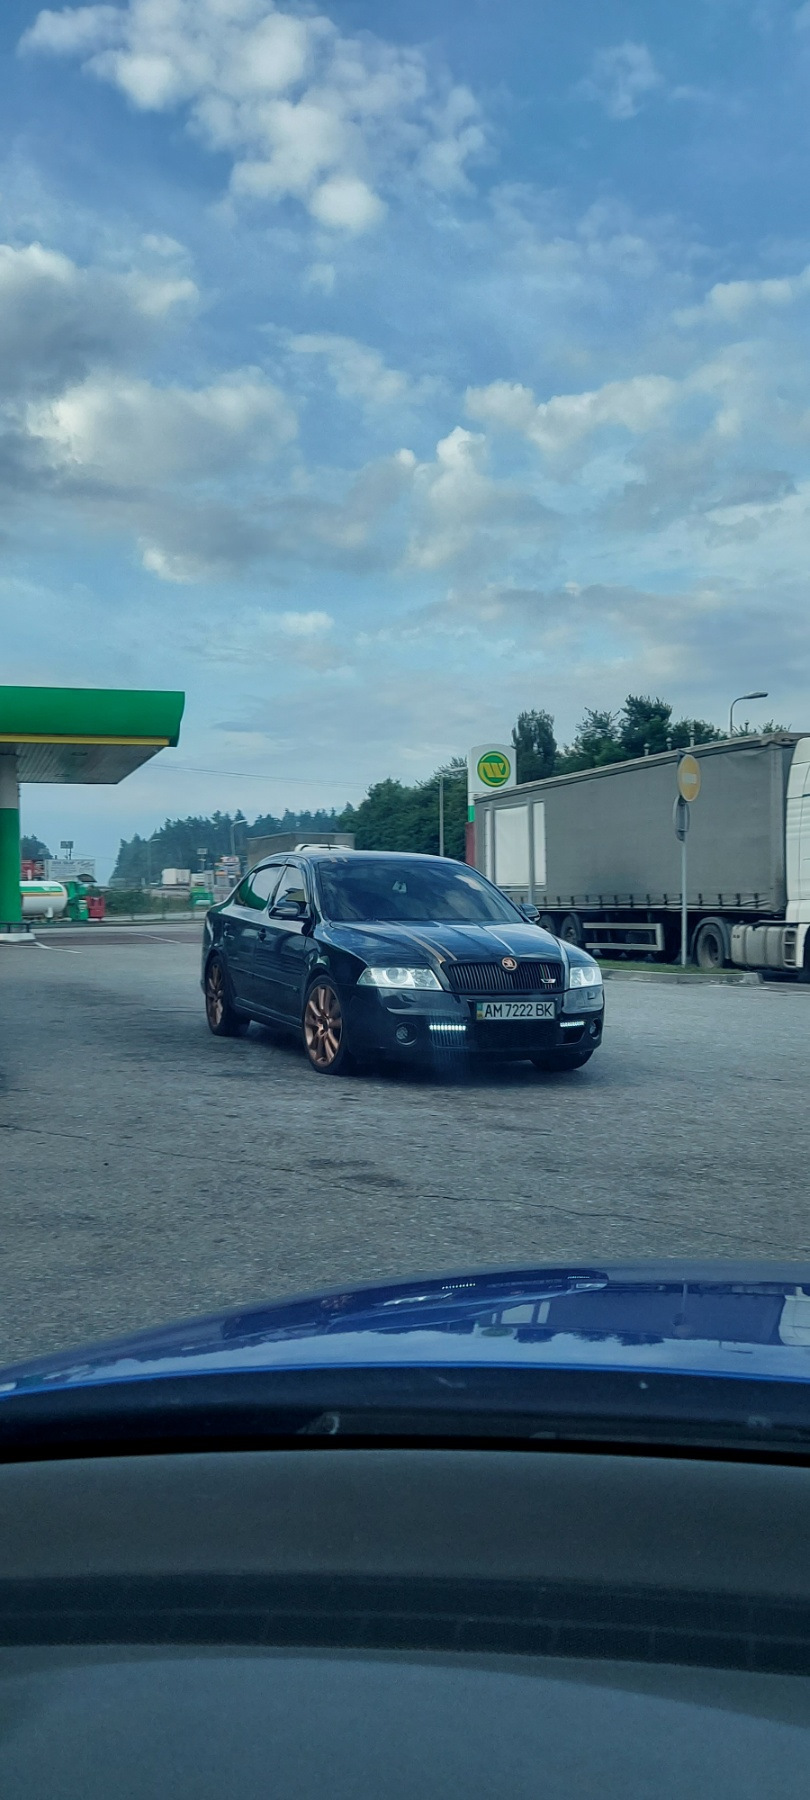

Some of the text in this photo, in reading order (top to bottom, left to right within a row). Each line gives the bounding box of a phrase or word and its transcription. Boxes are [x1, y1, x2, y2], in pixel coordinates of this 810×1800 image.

[484, 1003, 553, 1018] AM 7222 BK
